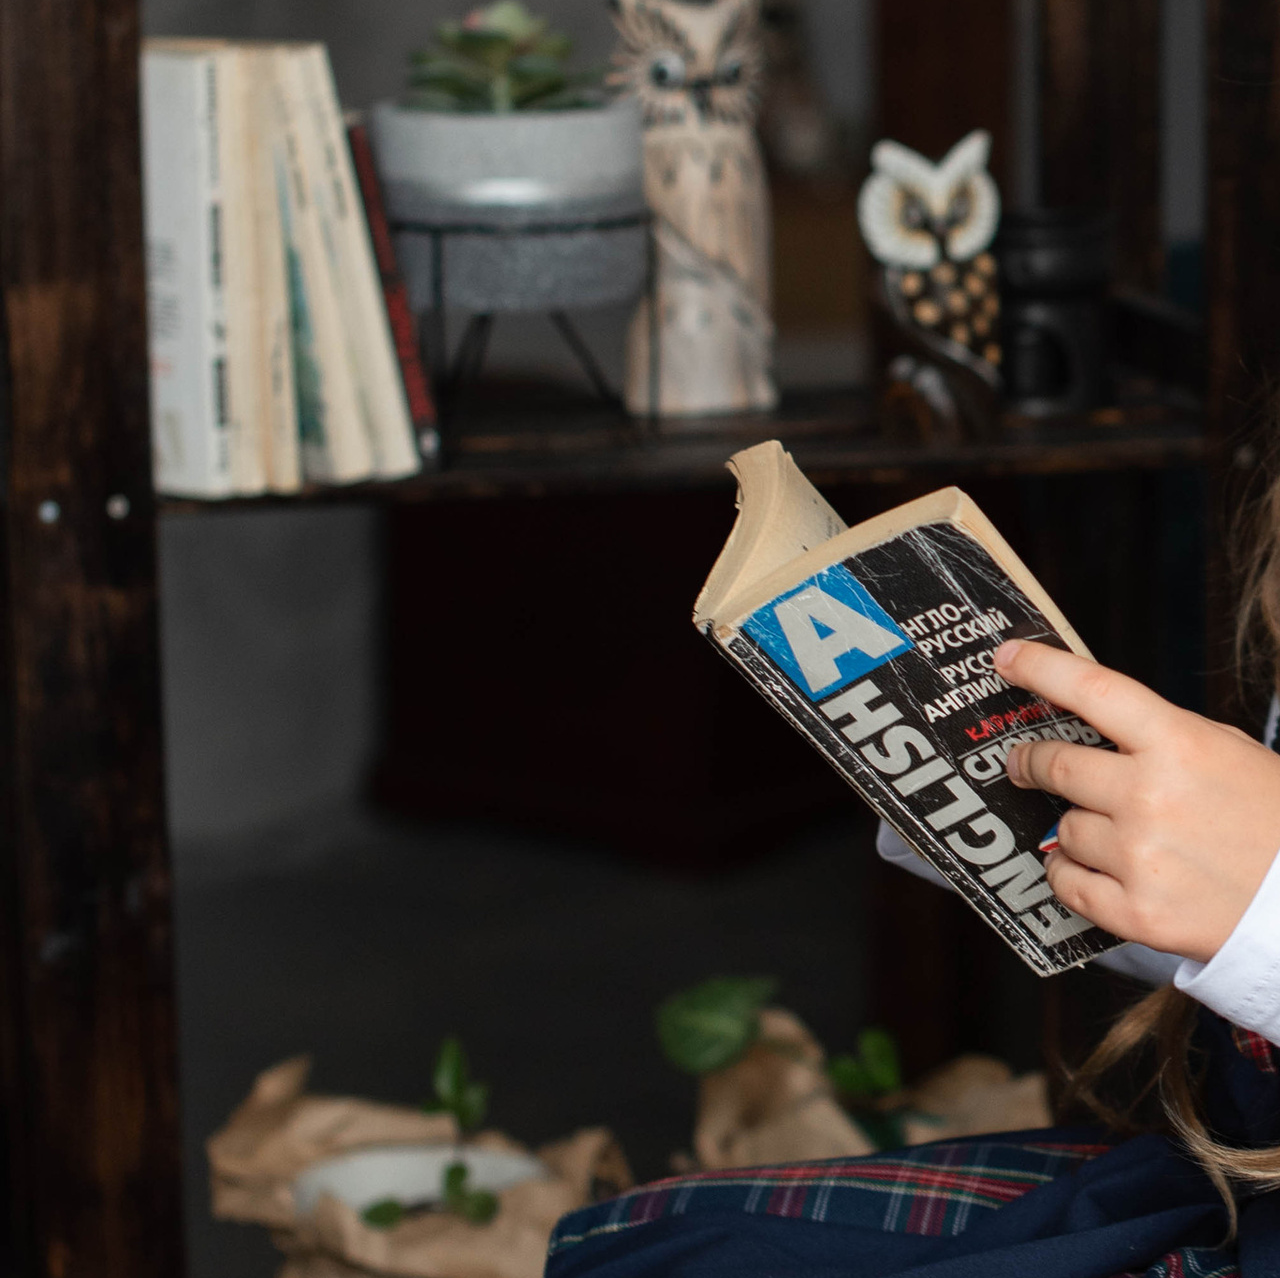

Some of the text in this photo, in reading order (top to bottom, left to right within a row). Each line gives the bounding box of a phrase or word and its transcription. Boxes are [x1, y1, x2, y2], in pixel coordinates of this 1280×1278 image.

[916, 607, 1013, 658] РУССКИЙ
[962, 720, 1101, 781] СЛРЬ
[818, 678, 1096, 947] ENGLISH
